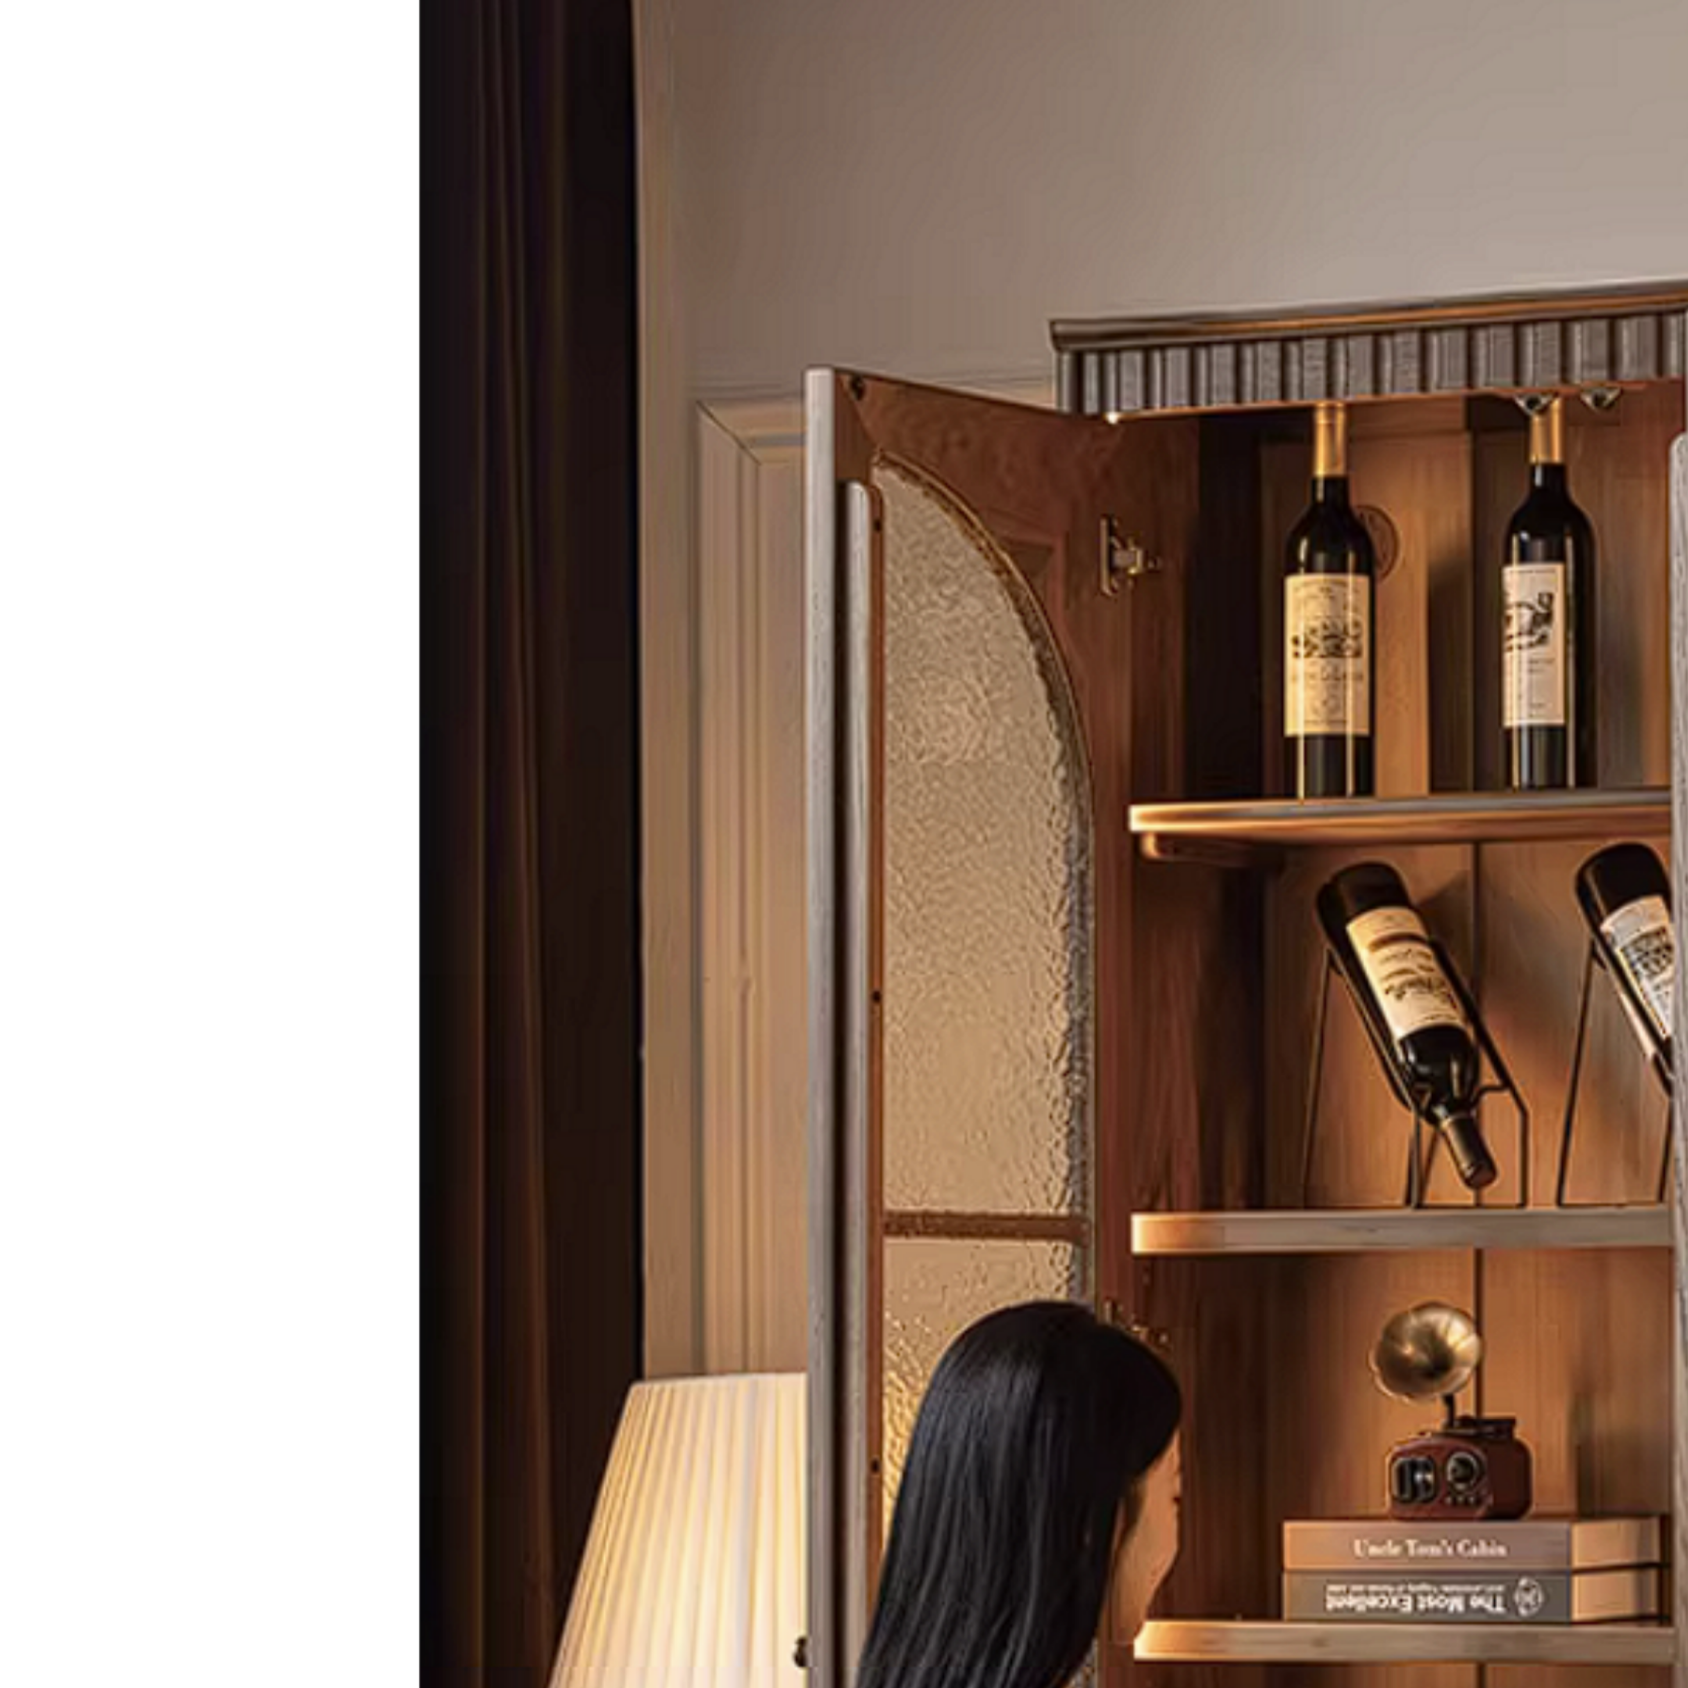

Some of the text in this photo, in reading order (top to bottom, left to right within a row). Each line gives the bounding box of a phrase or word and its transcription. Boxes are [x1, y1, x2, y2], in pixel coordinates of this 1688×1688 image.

[1353, 1539, 1508, 1558] Uncle Tom's Cabin
[1326, 1594, 1507, 1614] The Most Excellent
